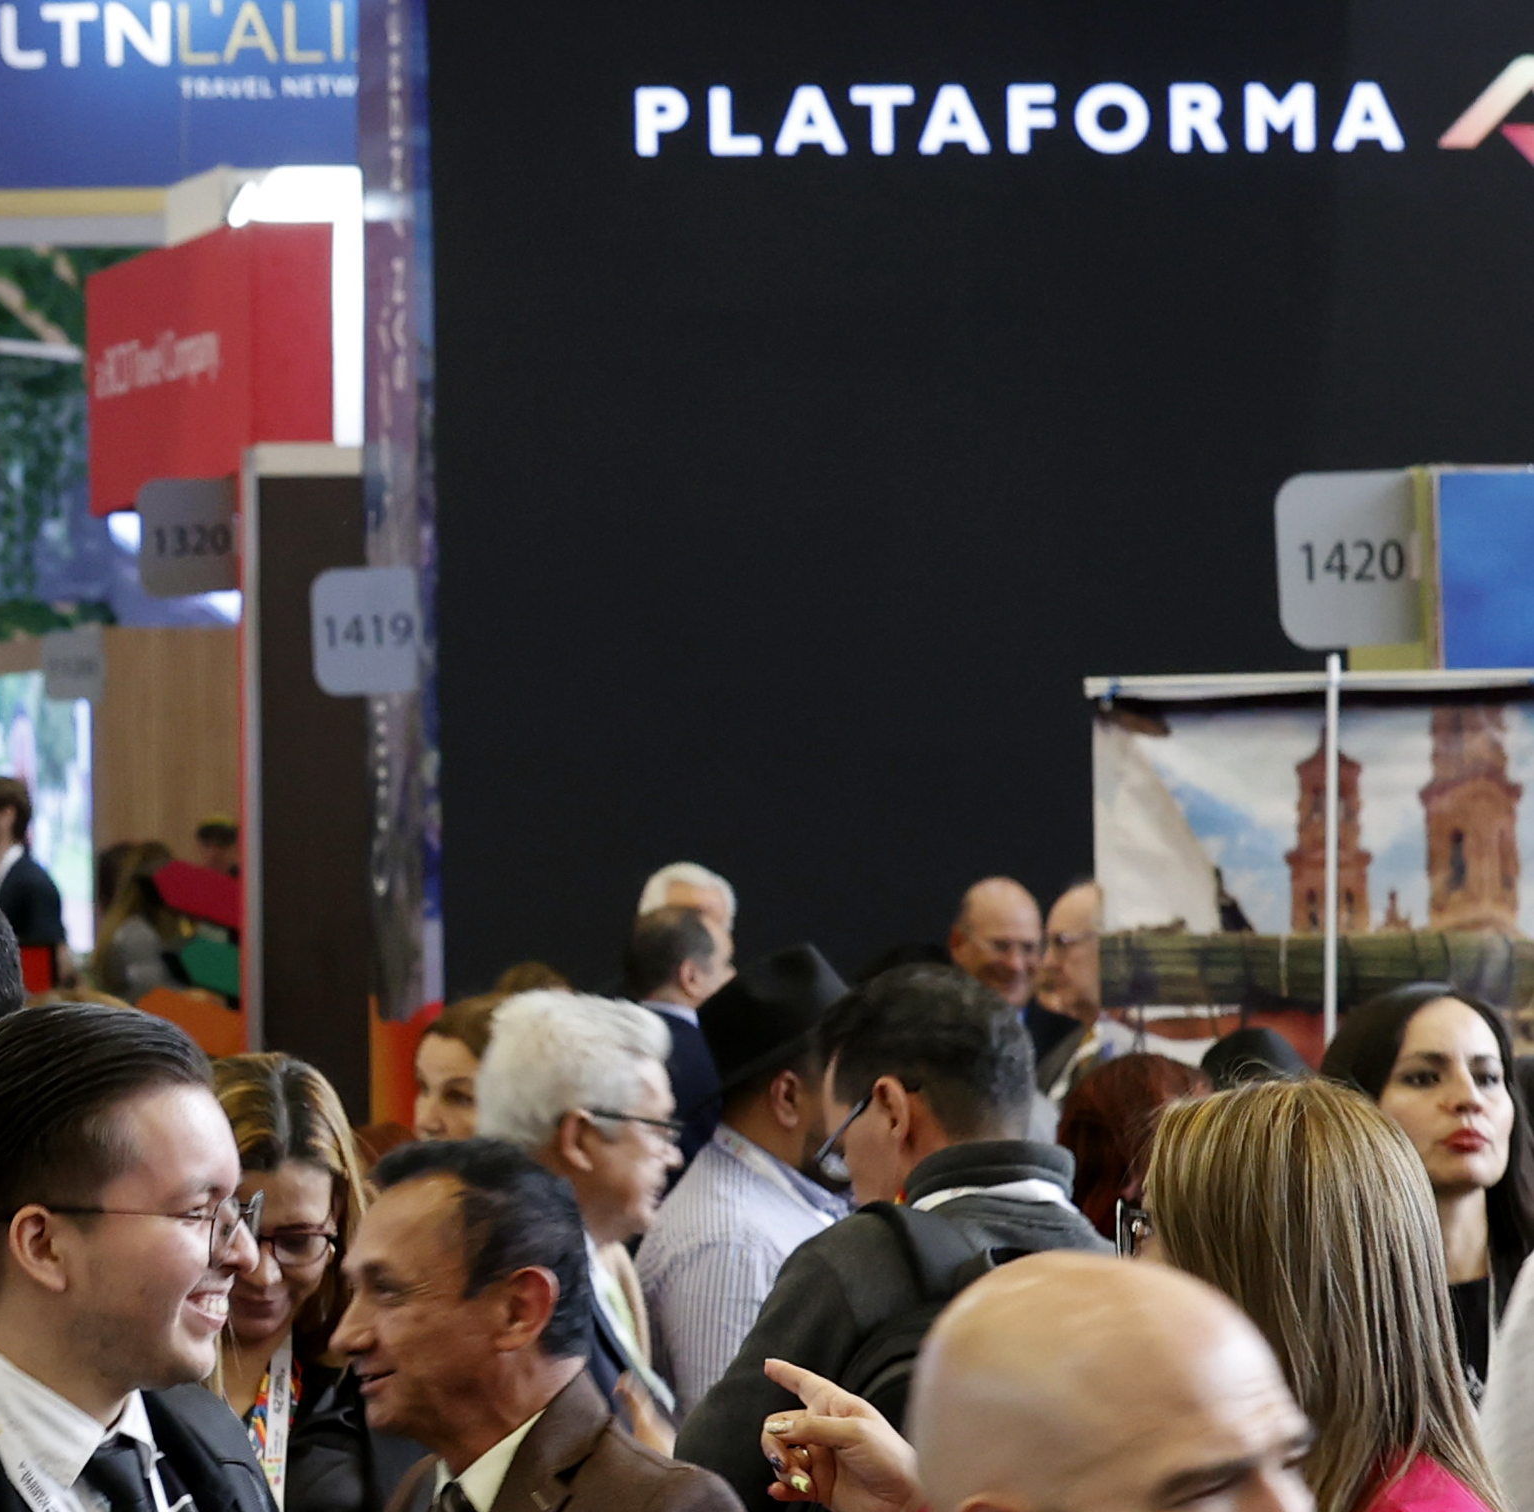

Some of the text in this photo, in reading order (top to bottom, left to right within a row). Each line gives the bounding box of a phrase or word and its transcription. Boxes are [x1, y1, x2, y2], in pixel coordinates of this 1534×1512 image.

[180, 76, 274, 99] TRAVEL
[634, 81, 1405, 157] PLATAFORMA
[1298, 538, 1406, 584] 1420
[323, 611, 415, 648] 1419
